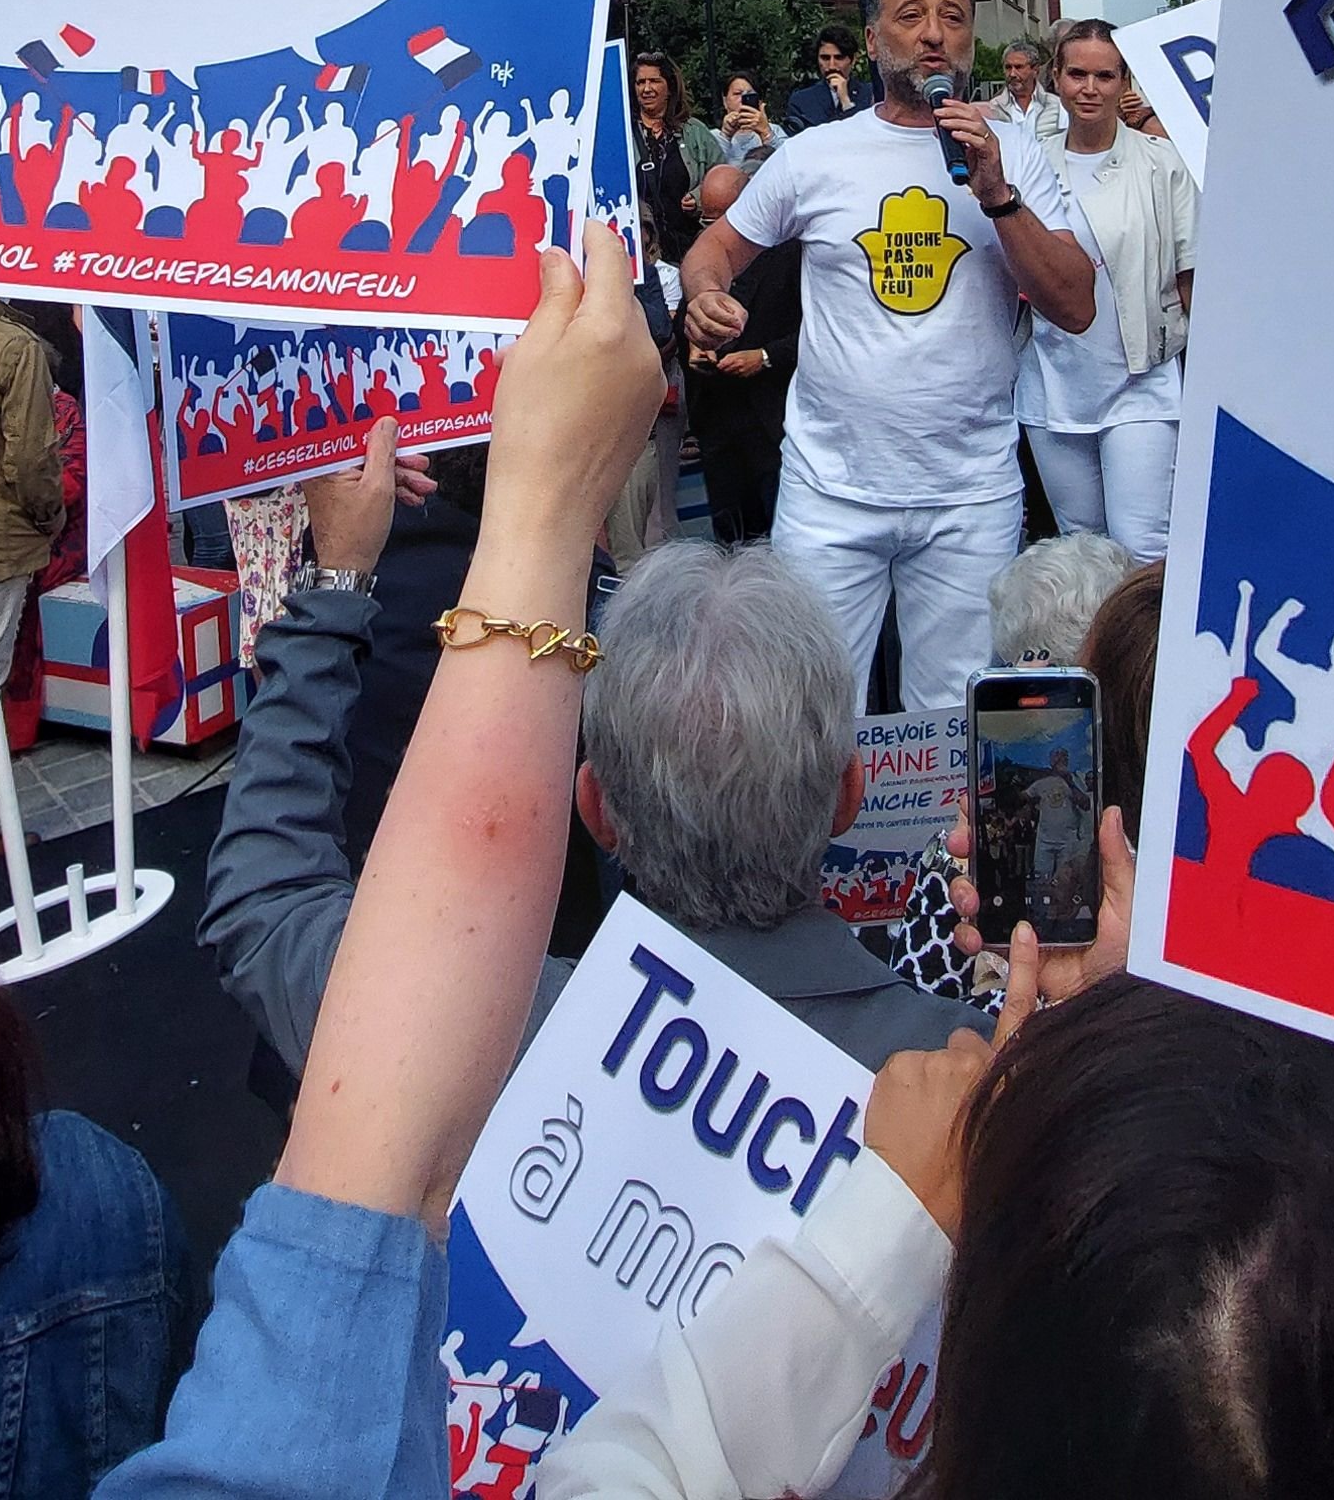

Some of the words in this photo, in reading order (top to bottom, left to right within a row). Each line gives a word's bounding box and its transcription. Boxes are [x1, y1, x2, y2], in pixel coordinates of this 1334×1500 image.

[884, 231, 942, 248] TOUCHE
[883, 248, 914, 264] PAS
[51, 250, 418, 300] #TOUCHEPASAMONFEUJ
[883, 265, 894, 279] A
[901, 263, 934, 279] MON
[880, 279, 913, 298] FEUJ
[243, 435, 359, 476] #CESSEZLEVIOL
